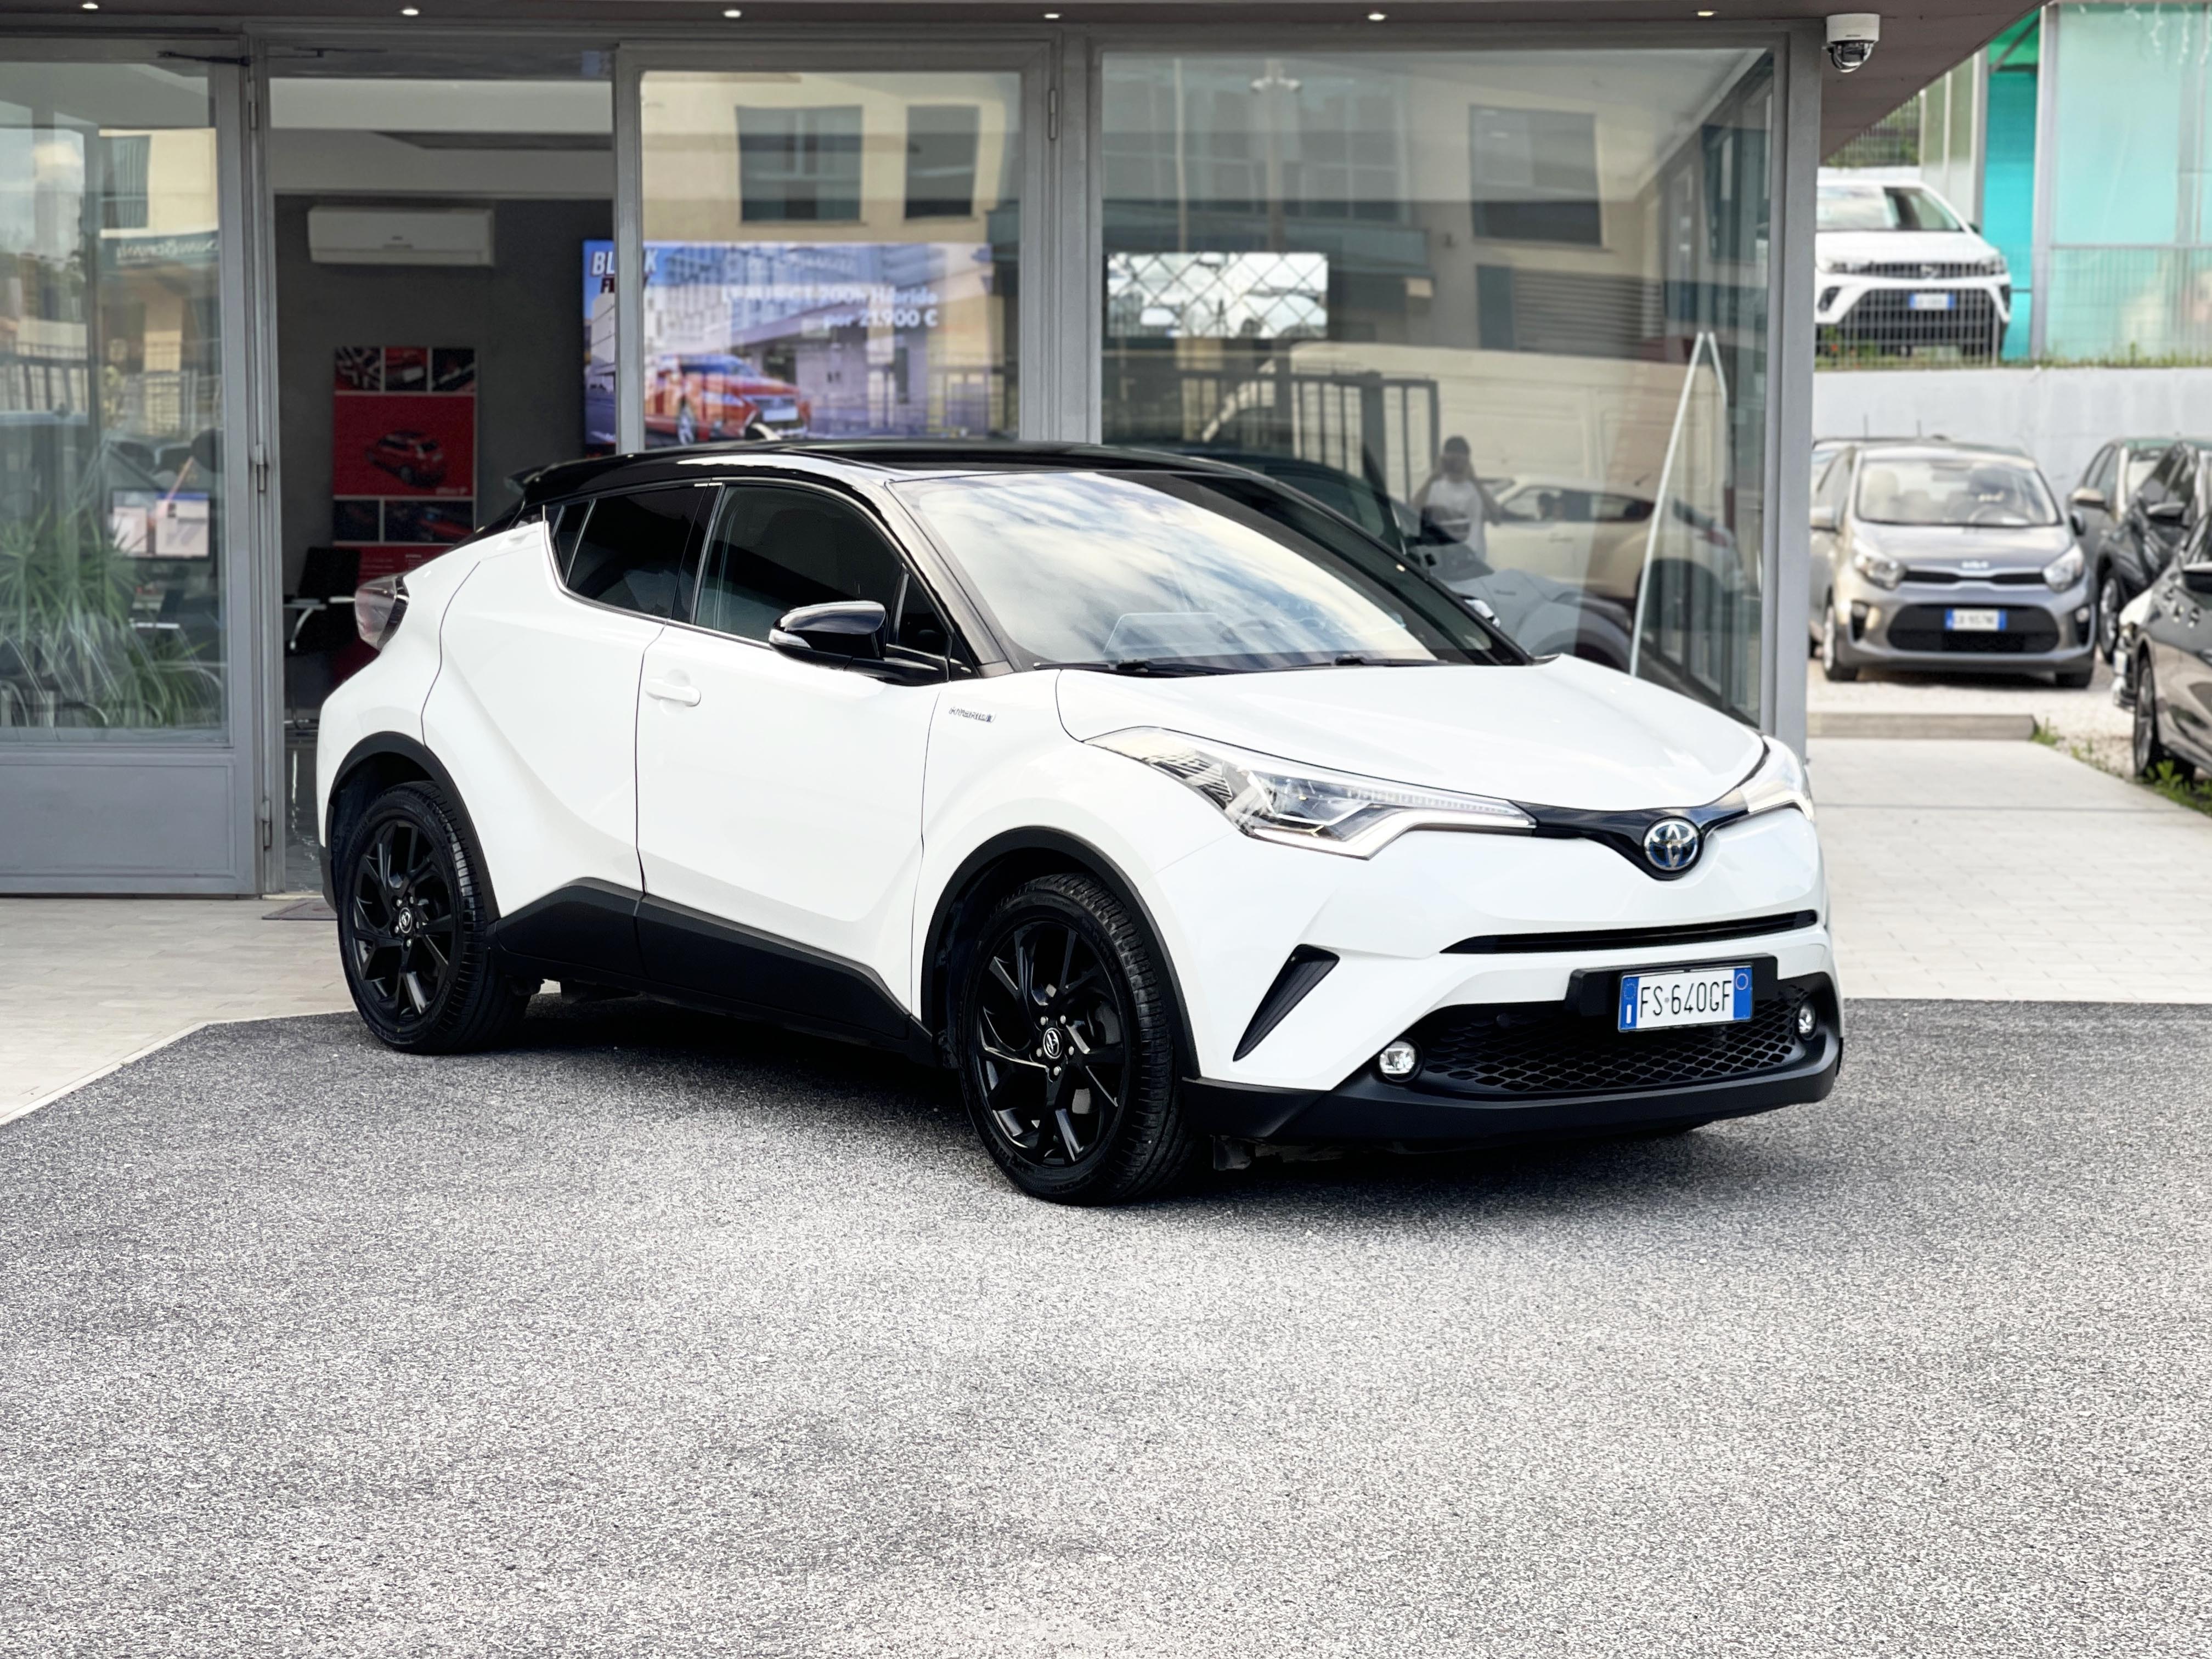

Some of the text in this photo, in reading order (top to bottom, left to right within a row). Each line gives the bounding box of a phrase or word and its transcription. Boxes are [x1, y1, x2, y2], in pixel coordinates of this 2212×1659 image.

[592, 248, 658, 276] BLK
[1640, 980, 1732, 1018] FS 640GF
